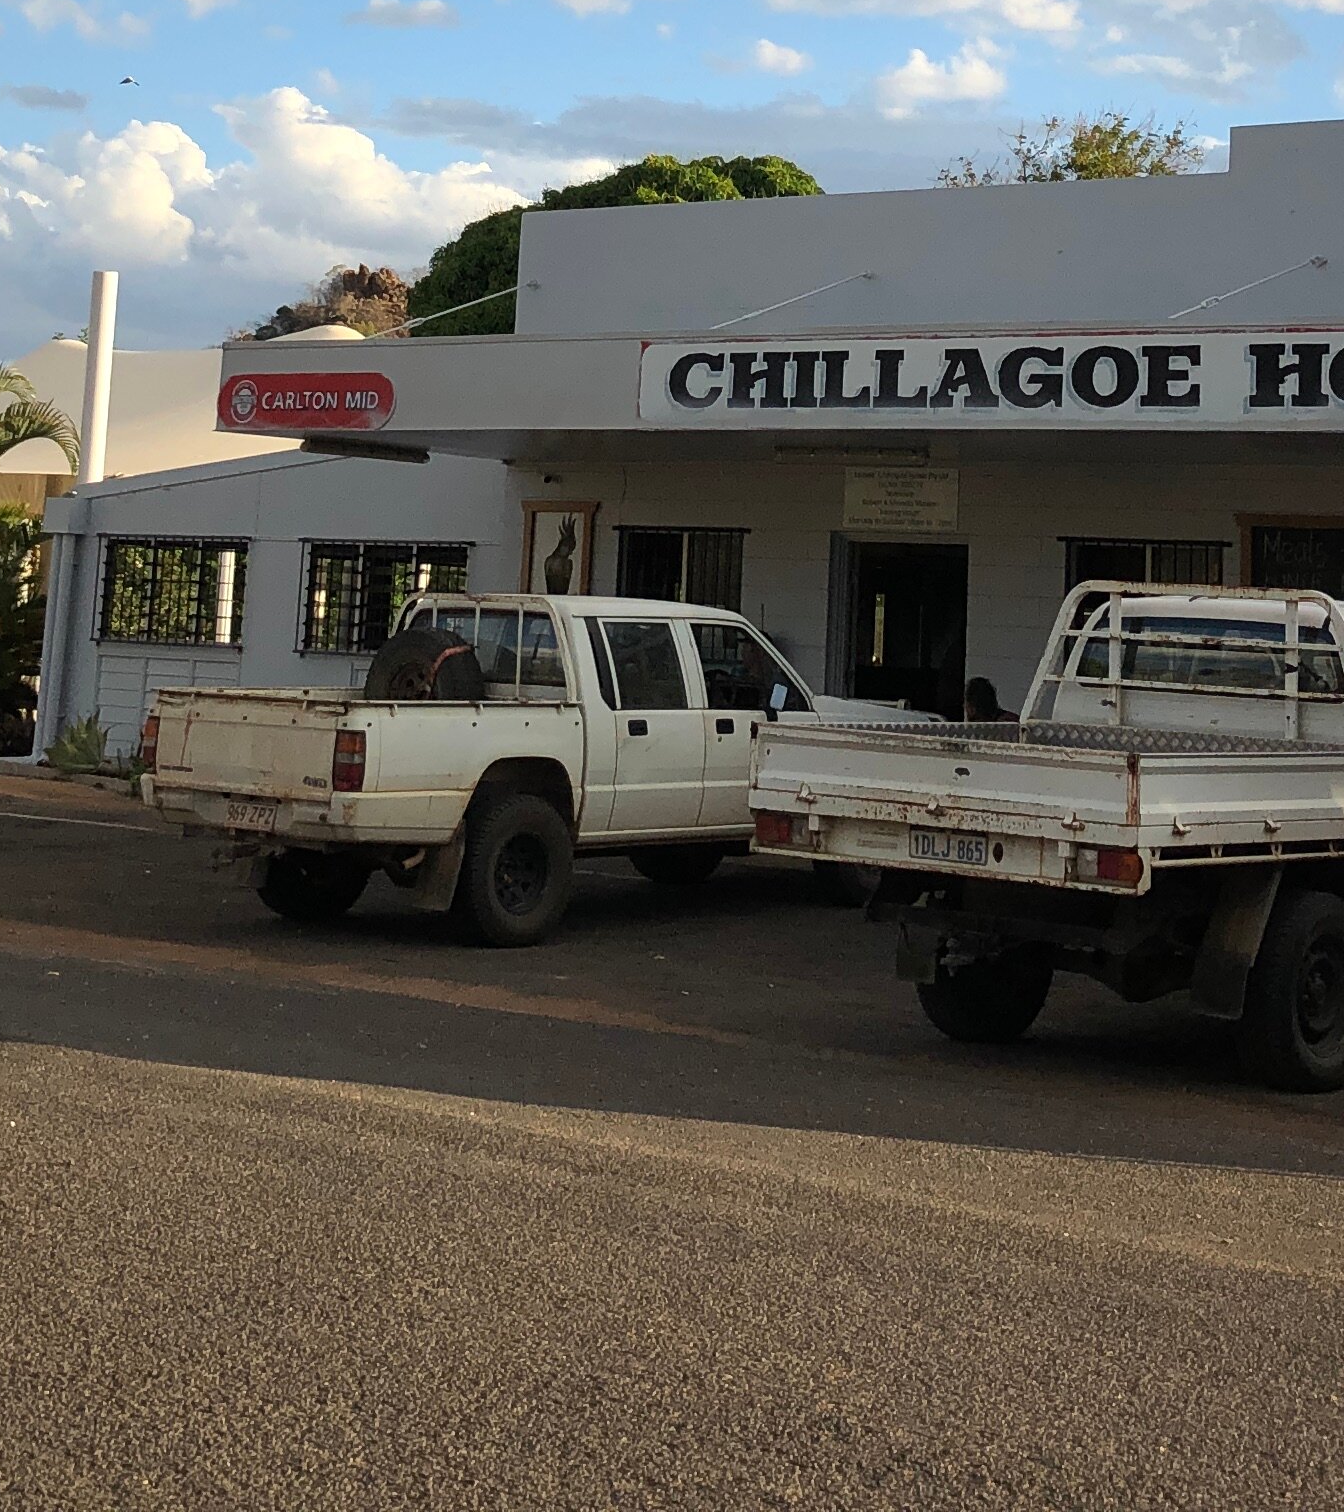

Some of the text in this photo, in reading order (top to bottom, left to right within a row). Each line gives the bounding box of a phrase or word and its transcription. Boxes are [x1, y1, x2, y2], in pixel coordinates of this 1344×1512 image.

[668, 345, 1202, 410] CHILLAGOE
[261, 391, 338, 410] CARLTON
[345, 391, 379, 410] MID
[914, 834, 951, 858] 1DLJ
[957, 839, 984, 862] 865
